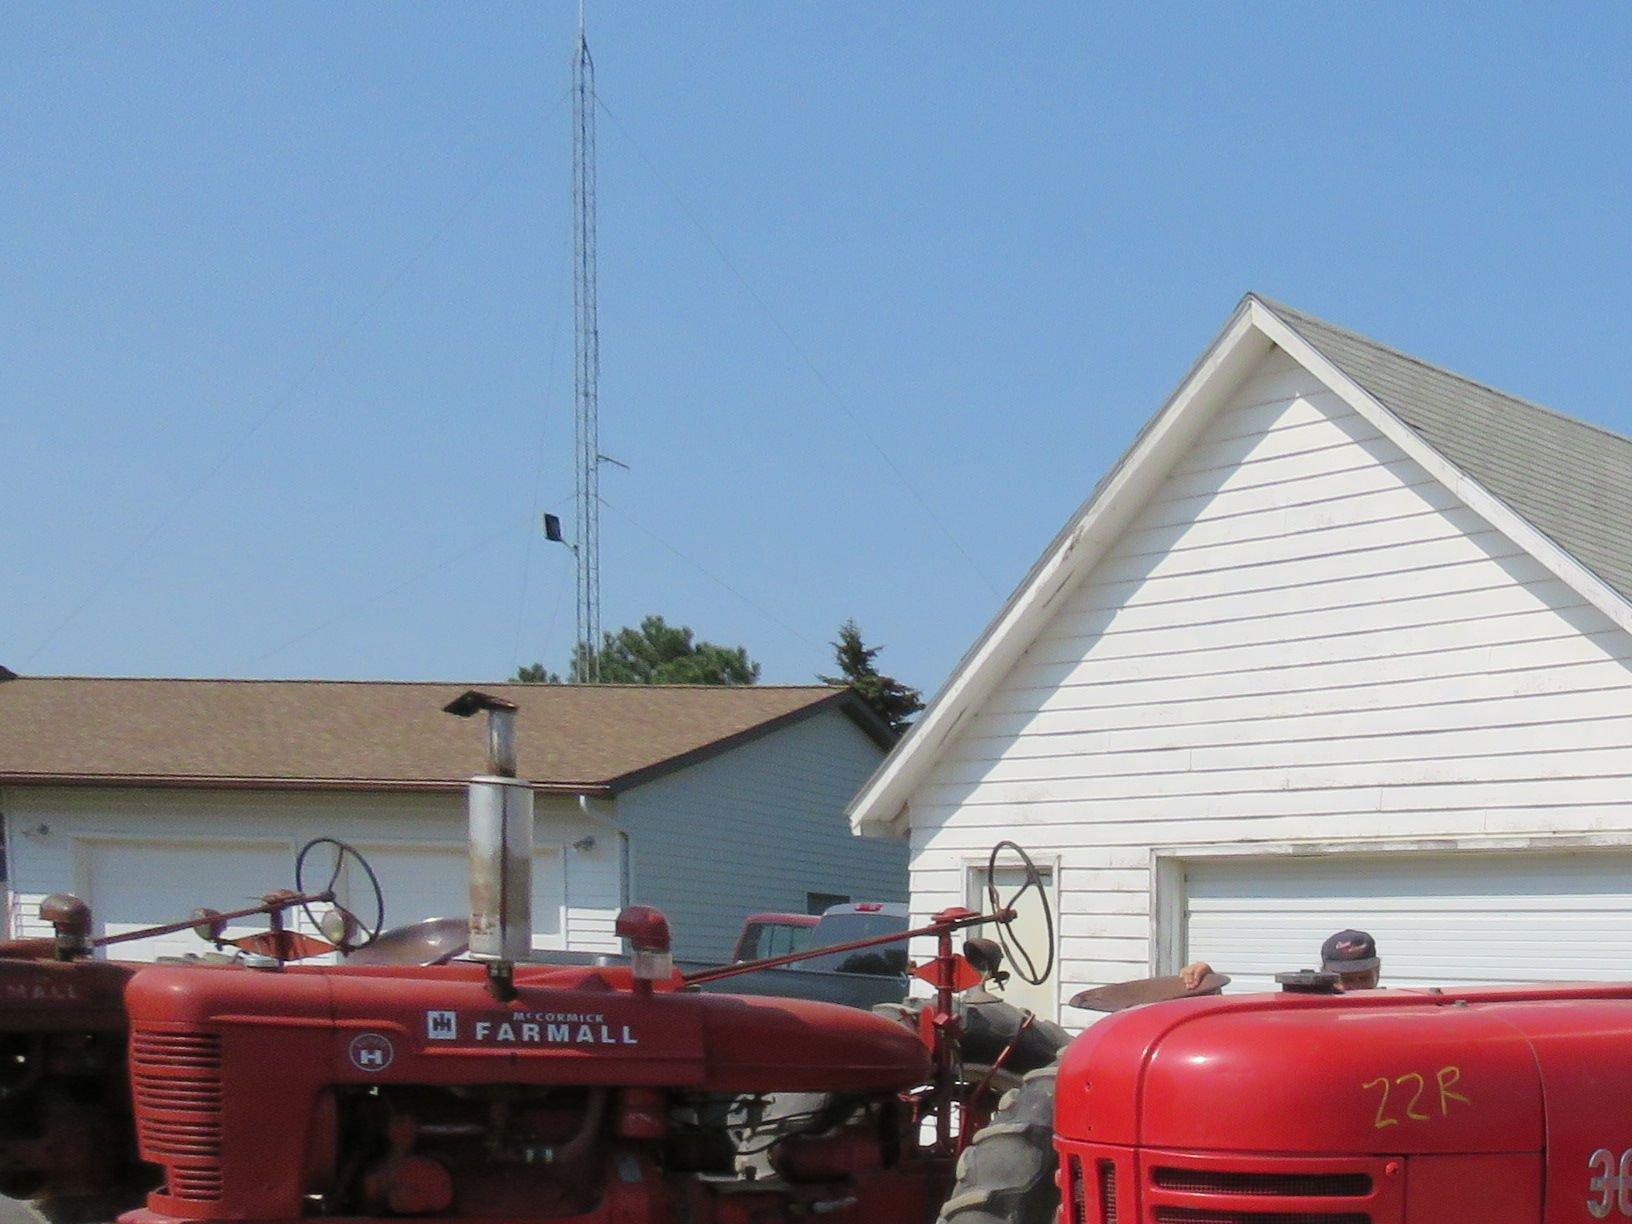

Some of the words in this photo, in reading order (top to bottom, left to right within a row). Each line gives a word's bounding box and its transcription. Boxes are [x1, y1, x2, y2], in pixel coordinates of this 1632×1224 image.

[475, 1021, 638, 1044] FARMALL
[360, 1049, 383, 1065] H
[1362, 1065, 1471, 1129] 22R
